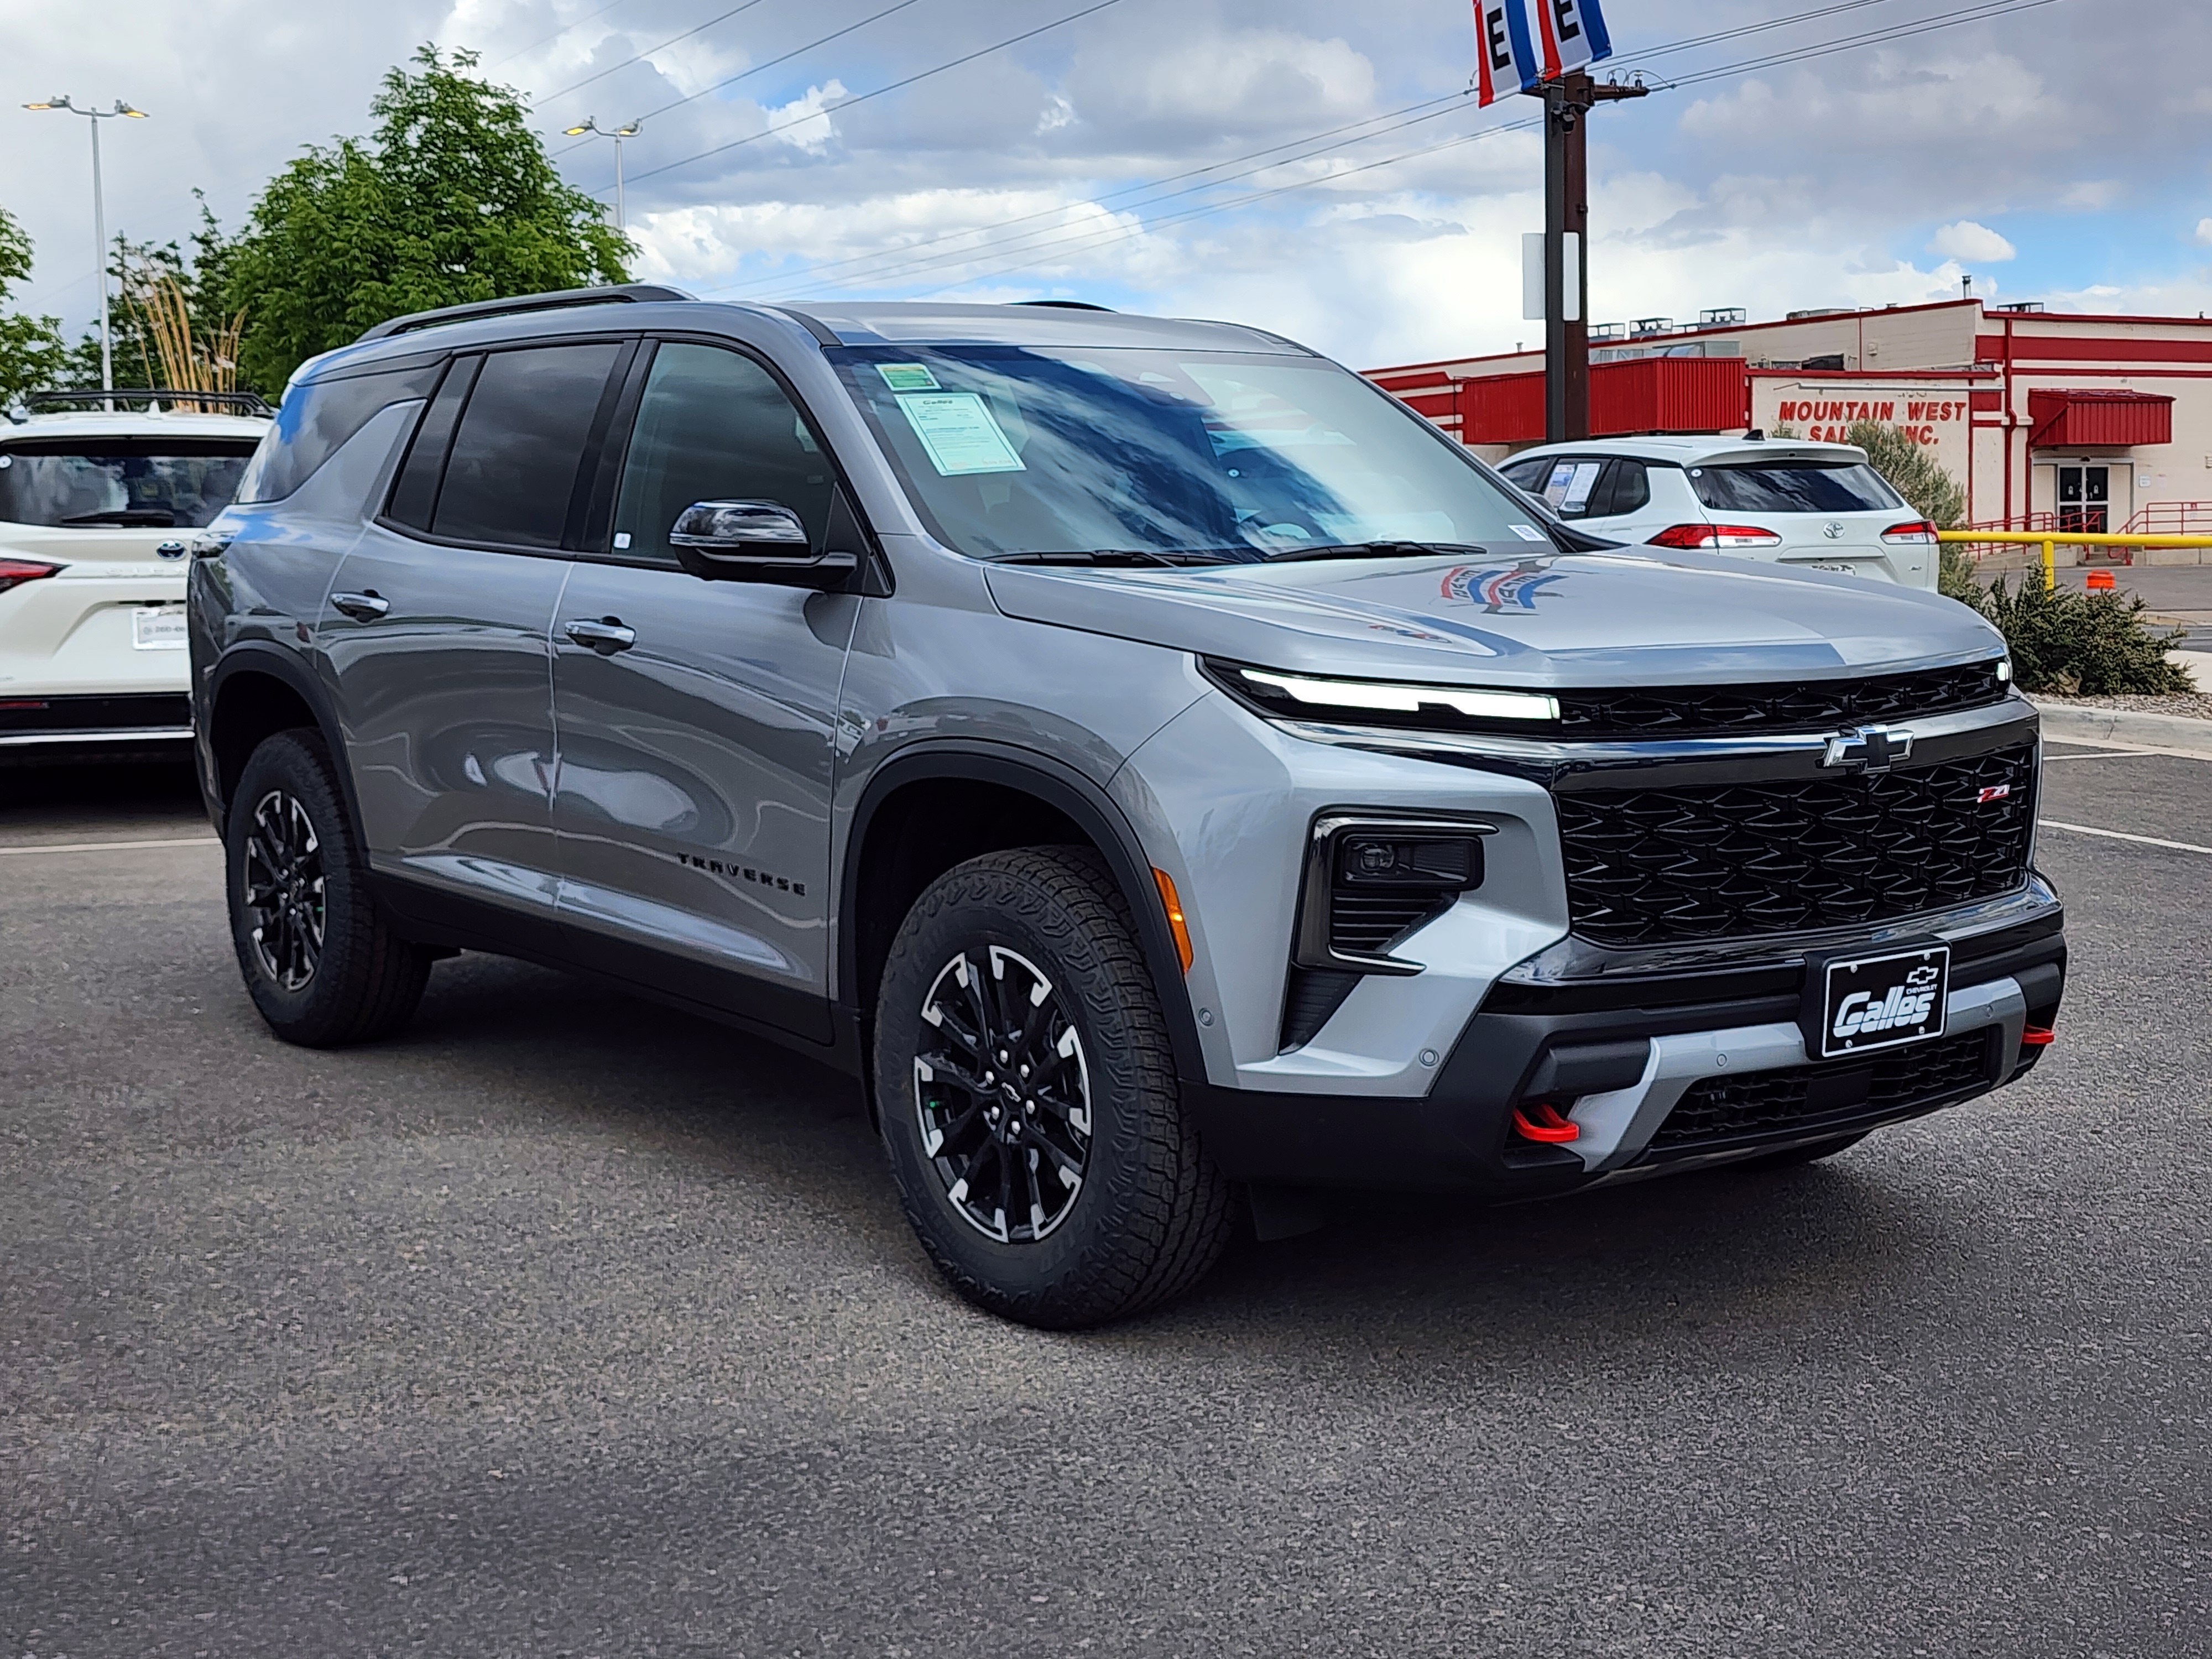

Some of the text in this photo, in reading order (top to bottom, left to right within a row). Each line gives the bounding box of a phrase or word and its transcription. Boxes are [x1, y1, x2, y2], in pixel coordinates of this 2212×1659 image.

[1778, 401, 1967, 421] MOUNTAIN WEST
[677, 852, 805, 896] TRAVERSE
[1833, 985, 1936, 1038] Galles
